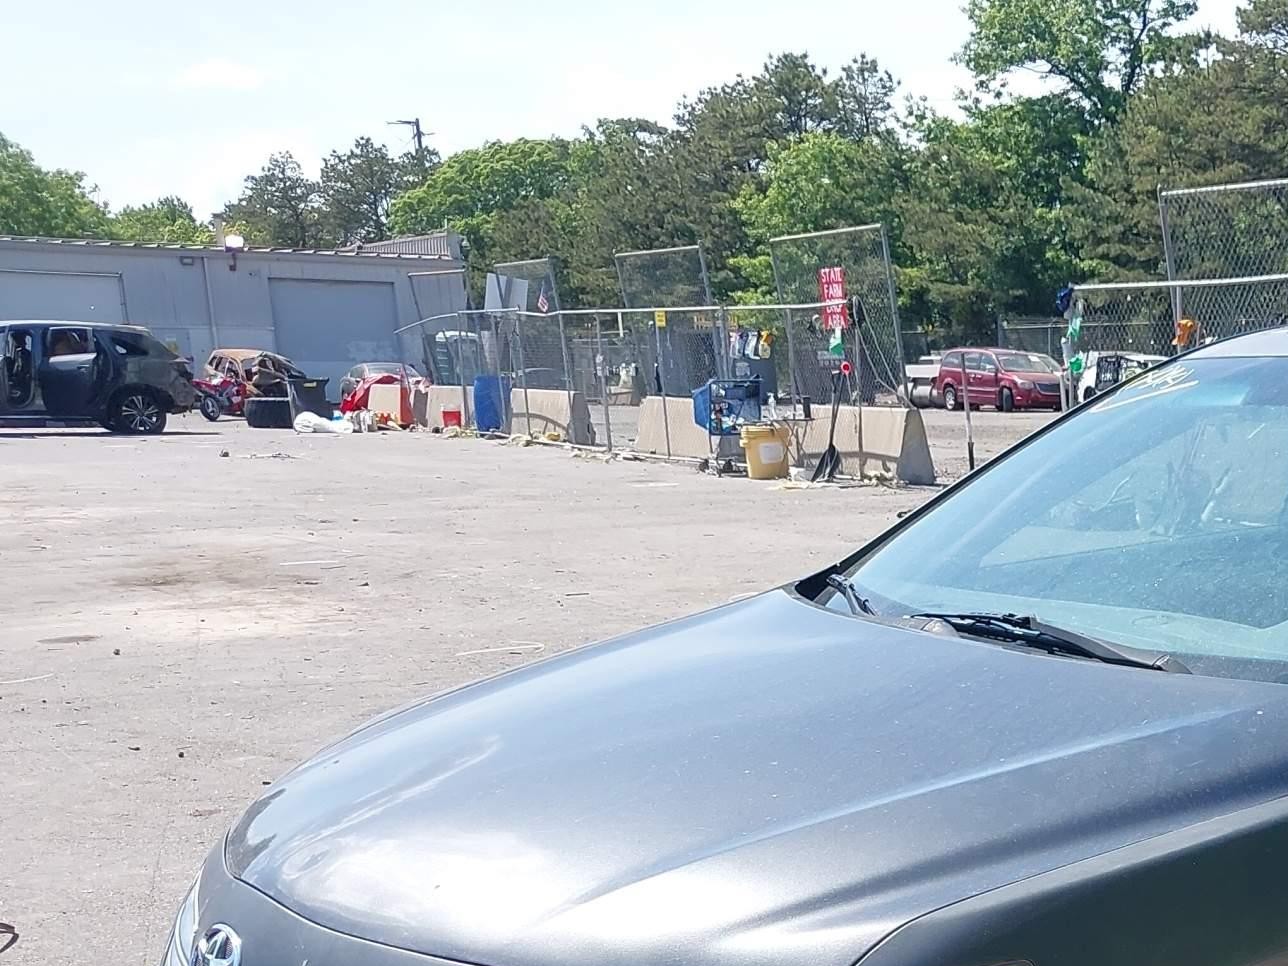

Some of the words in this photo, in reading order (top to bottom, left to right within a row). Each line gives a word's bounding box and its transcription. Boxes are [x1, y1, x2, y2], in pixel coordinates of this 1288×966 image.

[821, 268, 842, 283] STATE
[823, 283, 842, 299] FARM
[828, 315, 846, 328] AREA
